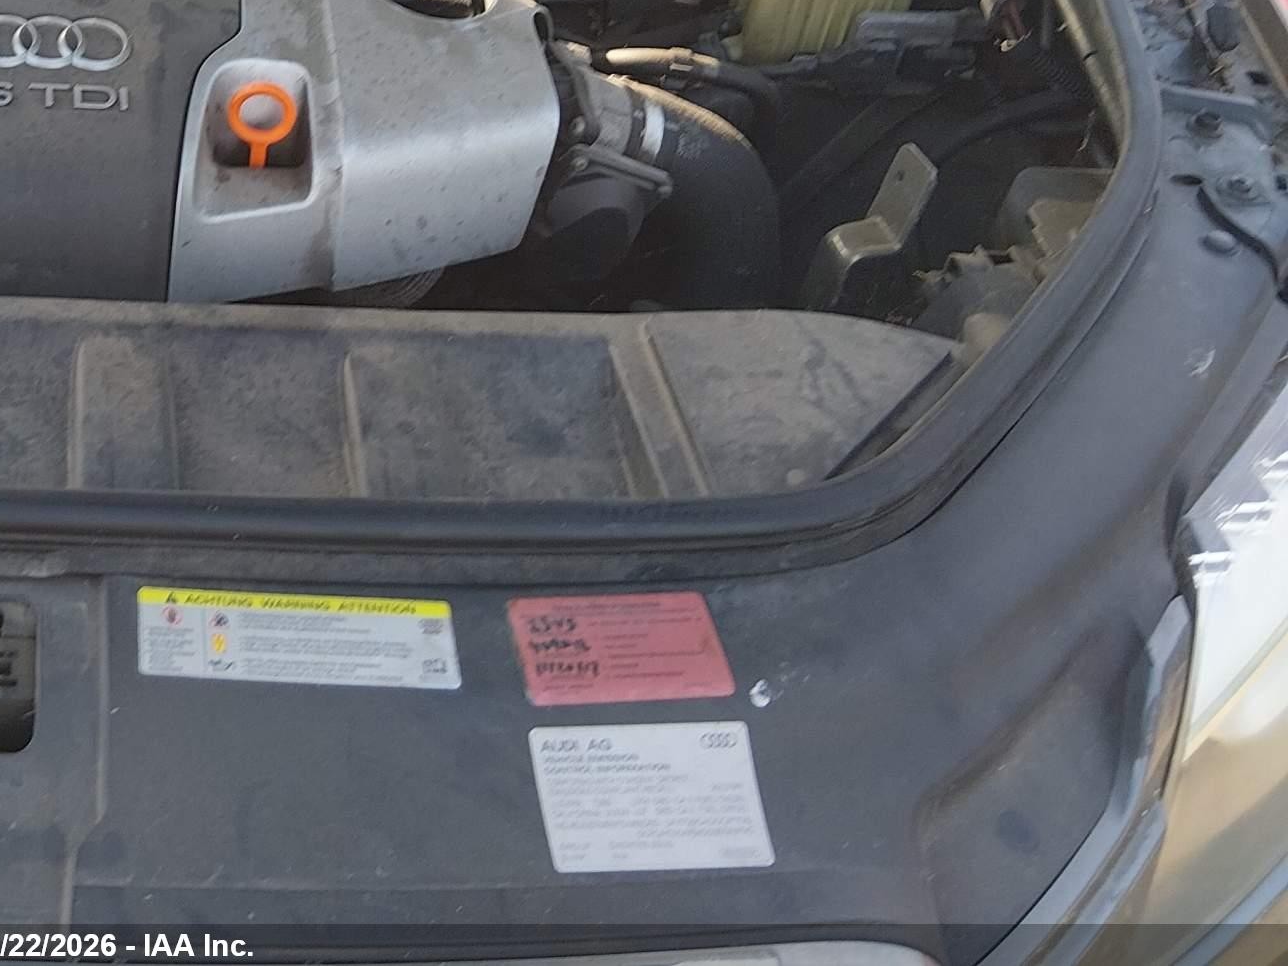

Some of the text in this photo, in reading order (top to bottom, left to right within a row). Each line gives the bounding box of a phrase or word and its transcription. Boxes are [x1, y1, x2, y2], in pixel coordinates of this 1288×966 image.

[27, 83, 129, 112] TDI
[183, 593, 417, 615] ACHTUNG WARNING ATTENTION
[540, 737, 614, 753] AUDI AG
